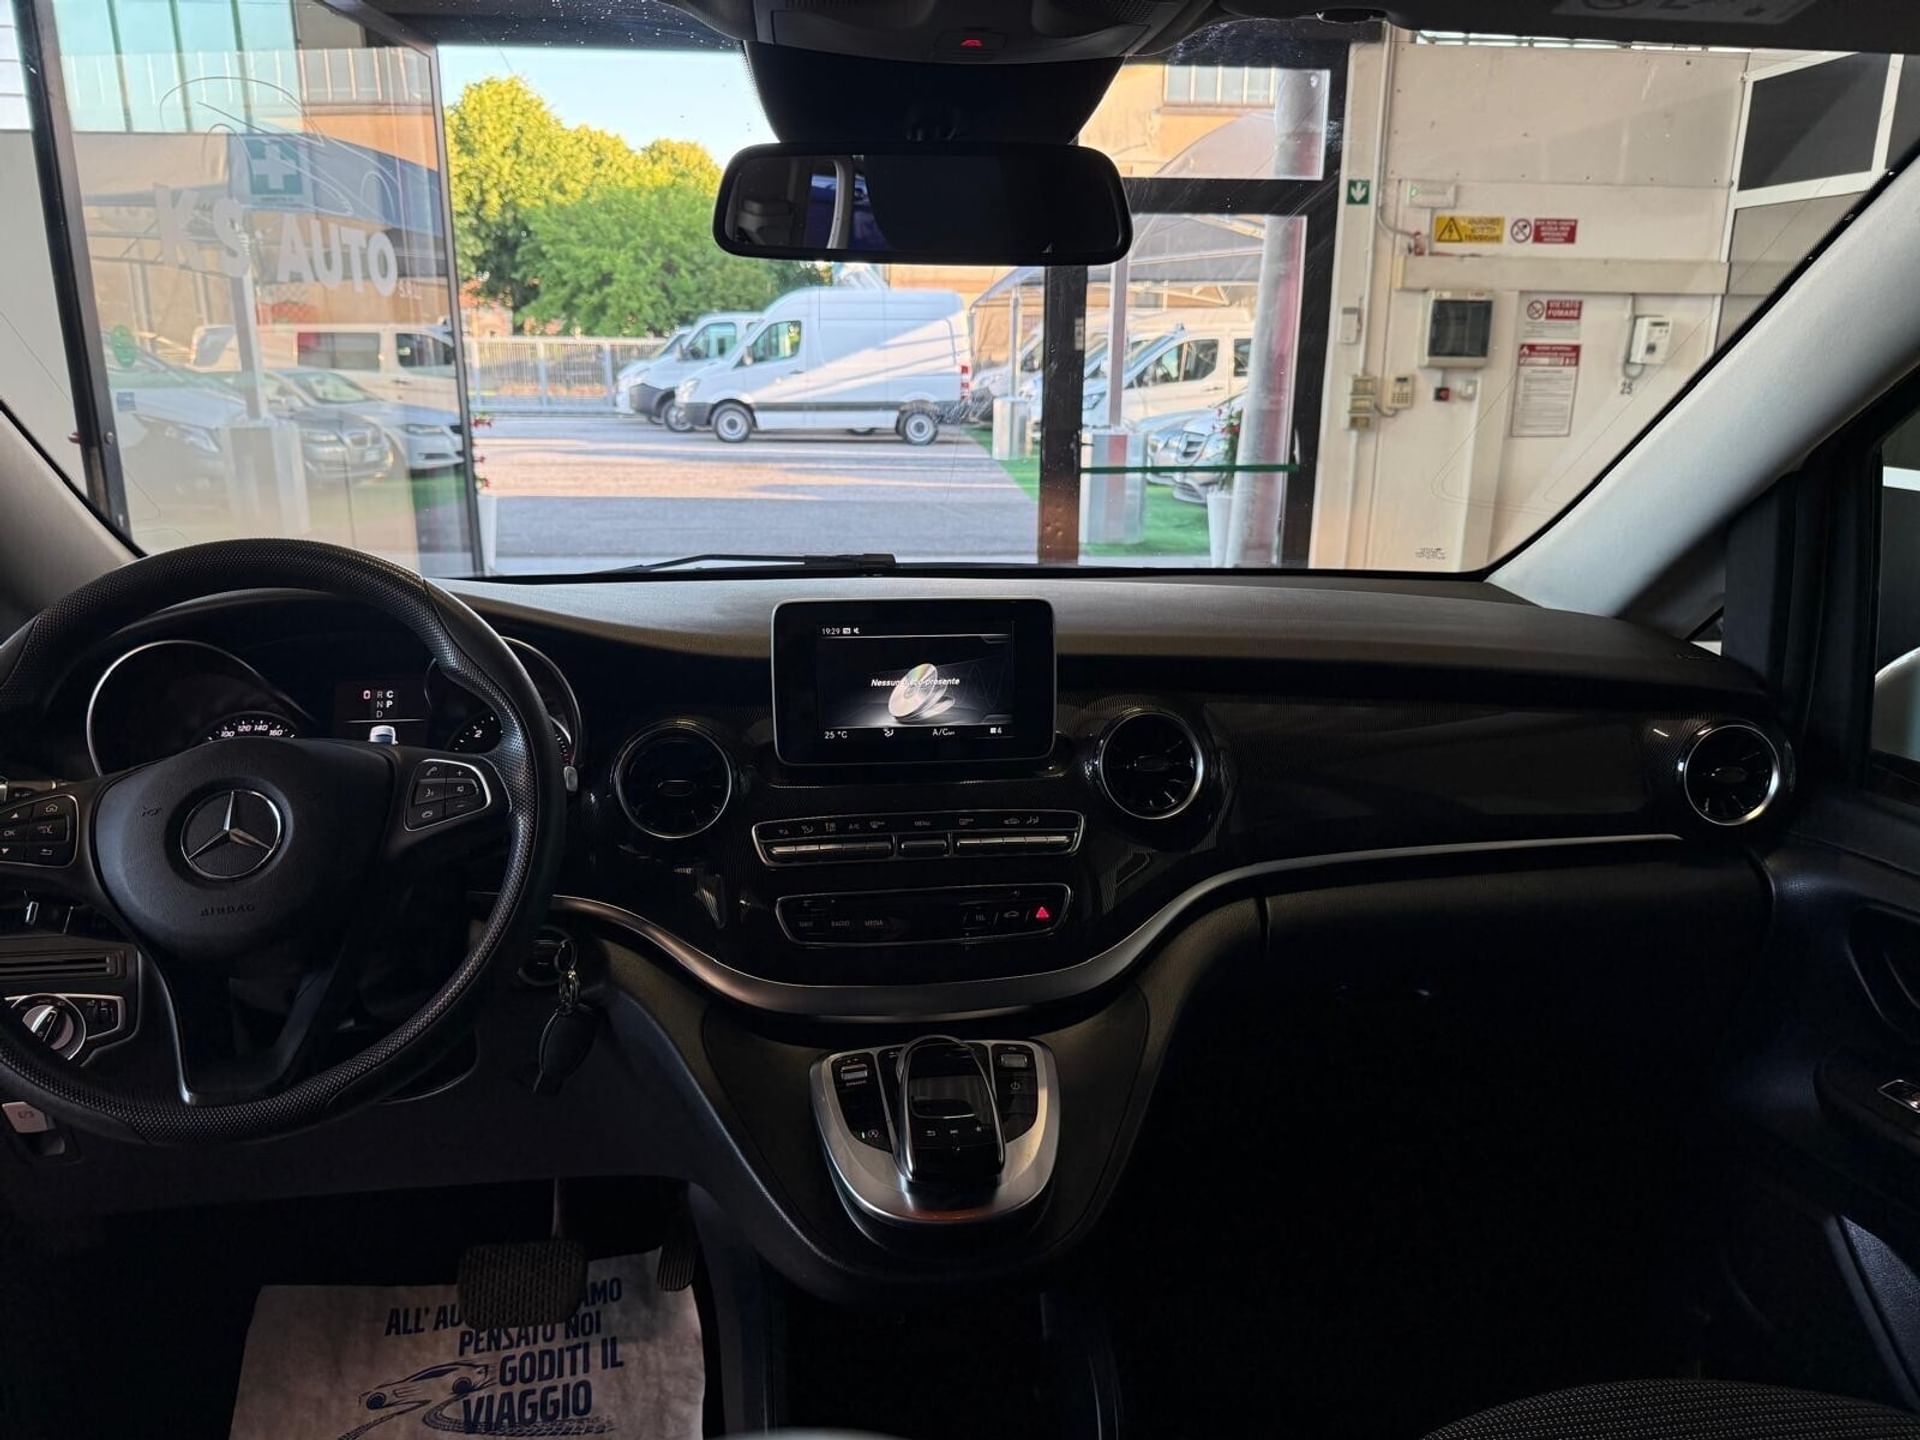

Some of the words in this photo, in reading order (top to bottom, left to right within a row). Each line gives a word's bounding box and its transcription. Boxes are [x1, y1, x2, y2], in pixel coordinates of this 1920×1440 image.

[276, 213, 399, 297] AUTO
[565, 1311, 602, 1340] NOI
[500, 1342, 590, 1387] GODITI
[602, 1336, 624, 1370] IL
[463, 1379, 592, 1434] VIAGGIO
